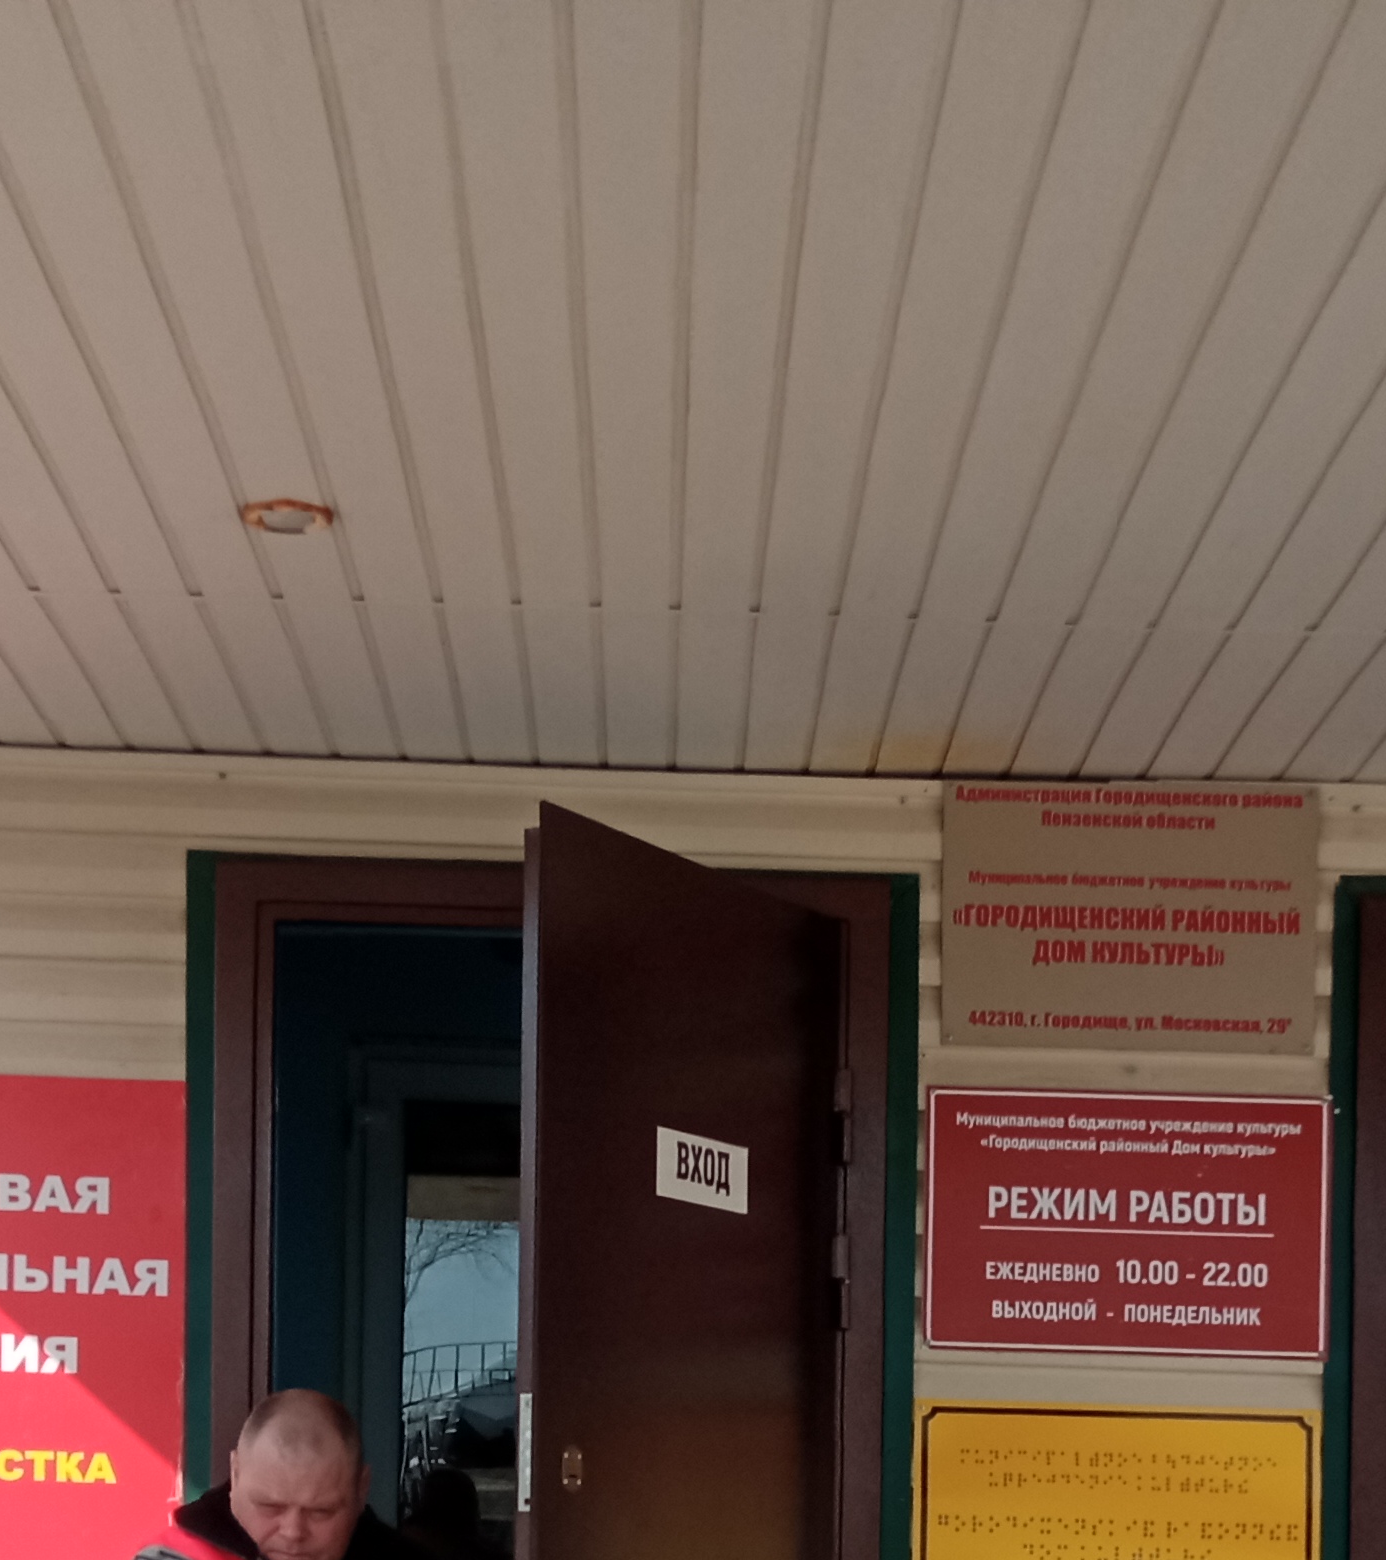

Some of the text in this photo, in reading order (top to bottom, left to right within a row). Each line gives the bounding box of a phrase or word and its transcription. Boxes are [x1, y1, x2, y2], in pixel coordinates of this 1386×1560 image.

[956, 785, 1303, 809] Администрация Городищенского района
[1041, 809, 1215, 830] Пензенской области
[953, 903, 1301, 935] «ГОРОДИЩЕНСКИЙ РАЙОННЫЙ
[1032, 940, 1225, 967] ДОМ КУЛЬТУРЫ»
[1044, 1012, 1131, 1031] Городище,
[956, 1112, 1301, 1137] Муниципальное бюджетное учреждение культуры
[981, 1134, 1276, 1159] «Городищенский районный Дом культуры»
[676, 1140, 731, 1197] ВХОД
[988, 1186, 1267, 1226] РЕЖИМ РАБОТЫ
[985, 1261, 1100, 1283] ЕЖЕДНЕВНО
[1116, 1260, 1179, 1286] 10.00
[1202, 1262, 1268, 1288] 22.00
[992, 1298, 1097, 1322] ВЫХОДНОЙ
[1124, 1303, 1262, 1327] ПОНЕДЕЛЬНИК
